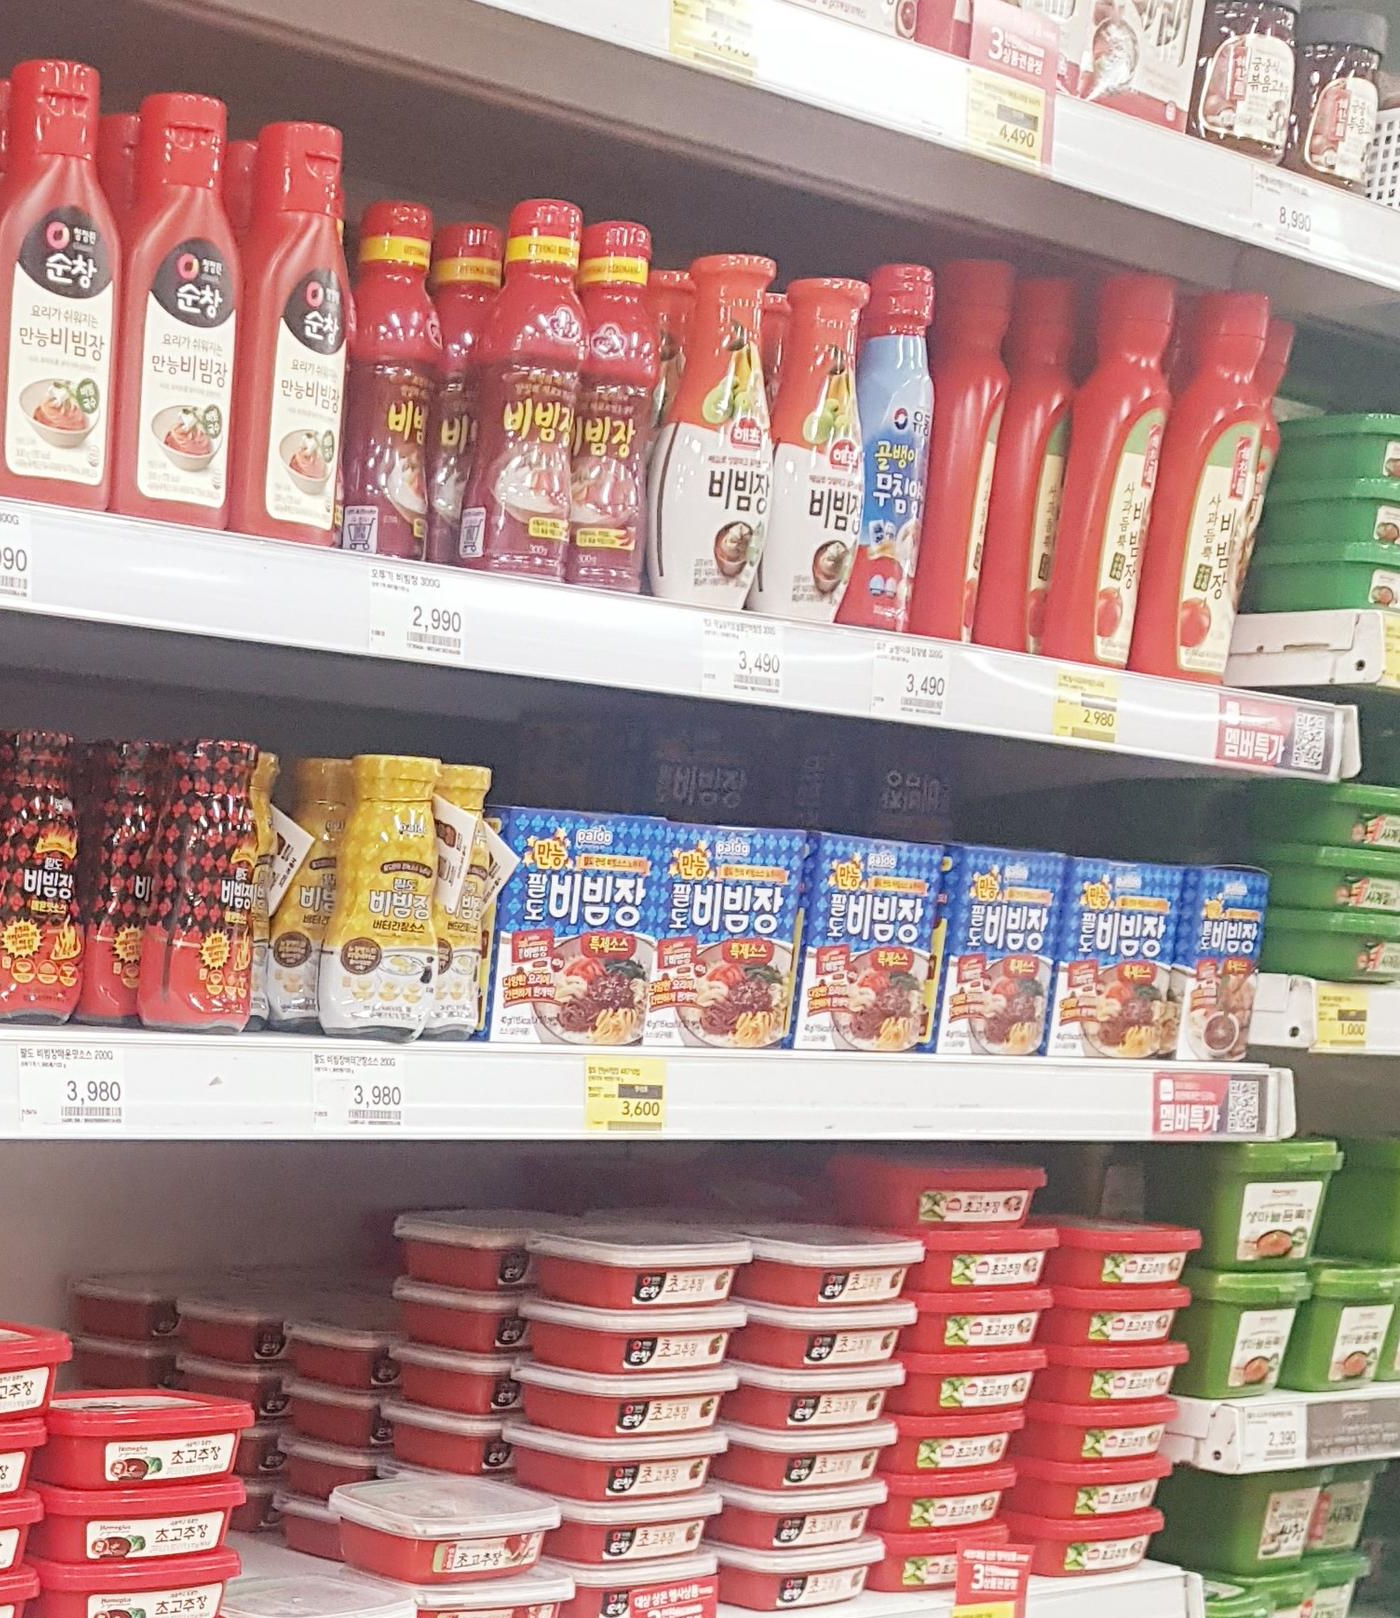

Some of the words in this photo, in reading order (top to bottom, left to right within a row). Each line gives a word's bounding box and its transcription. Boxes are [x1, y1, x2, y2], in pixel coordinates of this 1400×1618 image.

[988, 27, 1003, 59] 3
[1000, 124, 1036, 148] 4,490
[1280, 206, 1312, 233] 8,990
[304, 309, 341, 346] 순창
[18, 325, 105, 361] 만능비빔장
[151, 353, 229, 389] 만능비빔장
[707, 468, 770, 516] 비빔장
[412, 605, 461, 633] 2,990
[739, 651, 780, 674] 3,490
[906, 674, 945, 697] 3,490
[1083, 709, 1115, 729] 2,980
[1221, 729, 1284, 767] 멤버특가
[576, 826, 614, 847] paldo
[715, 839, 749, 858] paldo
[535, 842, 568, 869] 만능
[681, 852, 710, 878] 만능
[525, 872, 546, 922] 팔도
[548, 871, 647, 928] 비빔장
[670, 882, 690, 930] 팔도
[692, 883, 784, 935] 비빔장
[846, 893, 924, 945] 비빔장
[983, 903, 1049, 952] 비빔장
[588, 933, 629, 954] 특제소스
[1097, 913, 1167, 958] 비빔장
[1211, 919, 1258, 954] 비빔장
[729, 940, 768, 959] 특제소스
[1338, 1022, 1366, 1038] 1,000
[66, 1080, 121, 1105] 3,980
[354, 1084, 402, 1108] 3,980
[621, 1101, 660, 1117] 3,600
[1160, 1102, 1221, 1134] 멤버특가
[1267, 1430, 1297, 1448] 2,390
[457, 1550, 504, 1568] 초고추장
